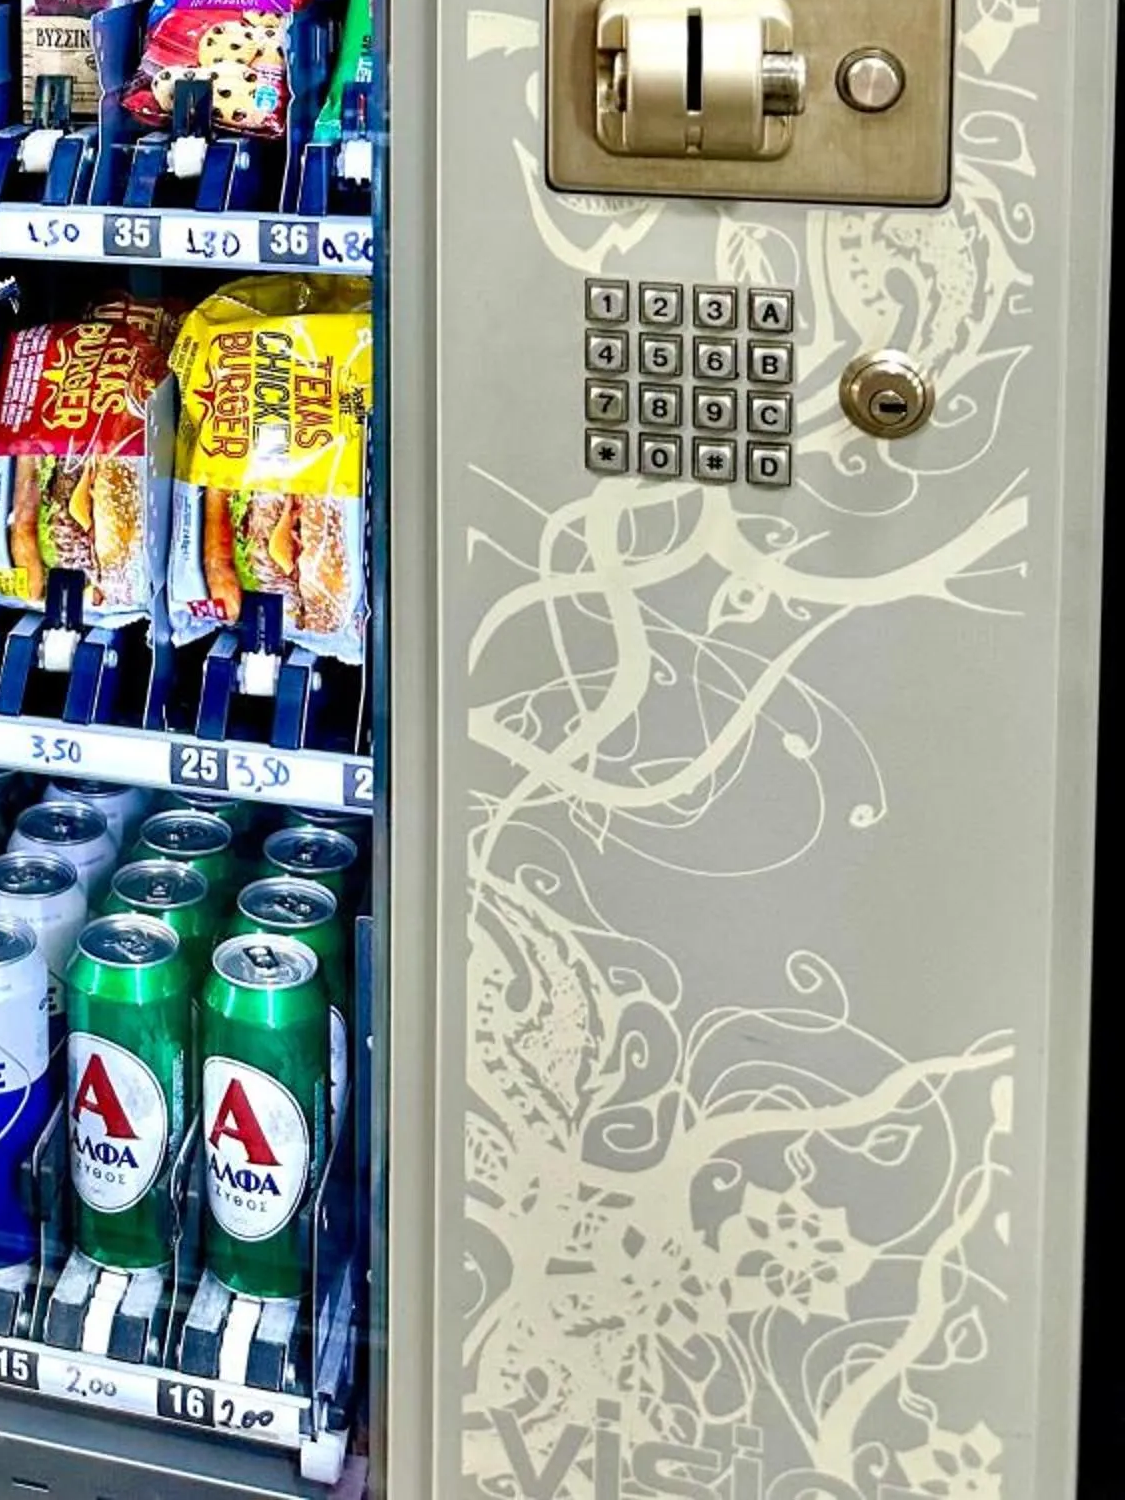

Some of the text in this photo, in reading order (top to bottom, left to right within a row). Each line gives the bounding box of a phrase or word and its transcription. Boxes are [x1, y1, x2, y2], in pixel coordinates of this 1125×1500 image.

[113, 216, 151, 247] 35
[269, 222, 309, 254] 36
[603, 293, 781, 325] 1 2 3 A
[54, 322, 115, 430] BURGER
[598, 345, 779, 375] 4 5 6 B
[211, 331, 253, 460] BURGER
[294, 356, 334, 449] TEXAS
[598, 393, 779, 426] 7 8 9 C
[651, 448, 668, 468] 0
[761, 457, 778, 477] D
[180, 747, 219, 781] 25
[208, 1154, 281, 1197] ΑΛΦΑ
[170, 1386, 205, 1418] 16
